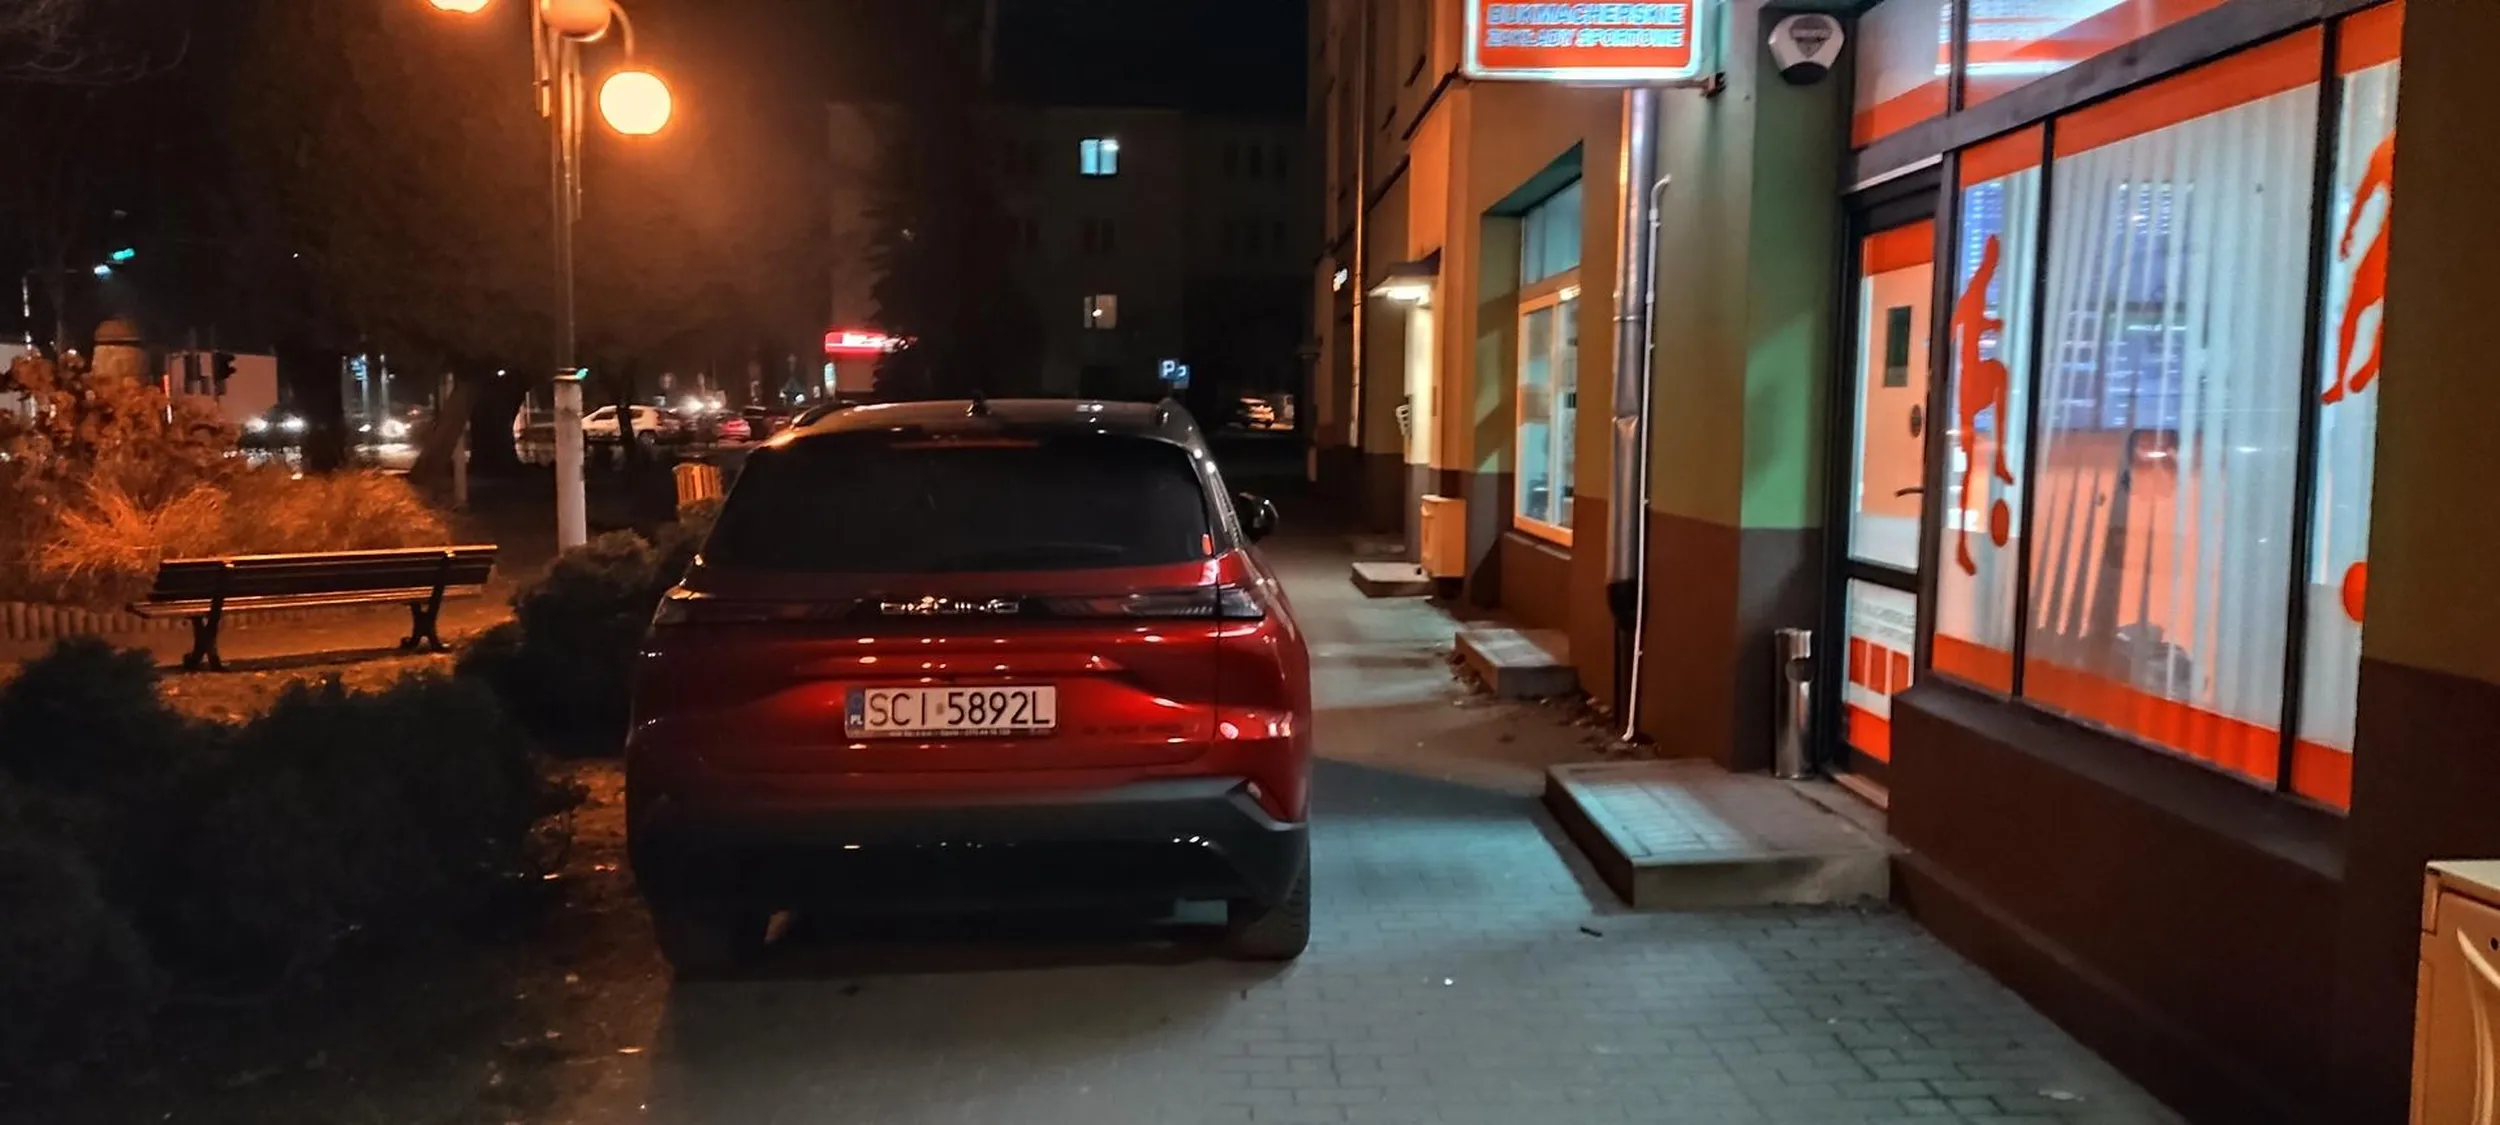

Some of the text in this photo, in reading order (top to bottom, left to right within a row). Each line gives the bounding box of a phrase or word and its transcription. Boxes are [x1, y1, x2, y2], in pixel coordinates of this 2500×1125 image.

[1487, 3, 1686, 25] BUKMACHERSKIE
[1576, 28, 1685, 47] SPORTOWE
[1162, 359, 1175, 378] P
[869, 690, 1050, 727] SCI 5892L
[850, 714, 863, 725] PL
